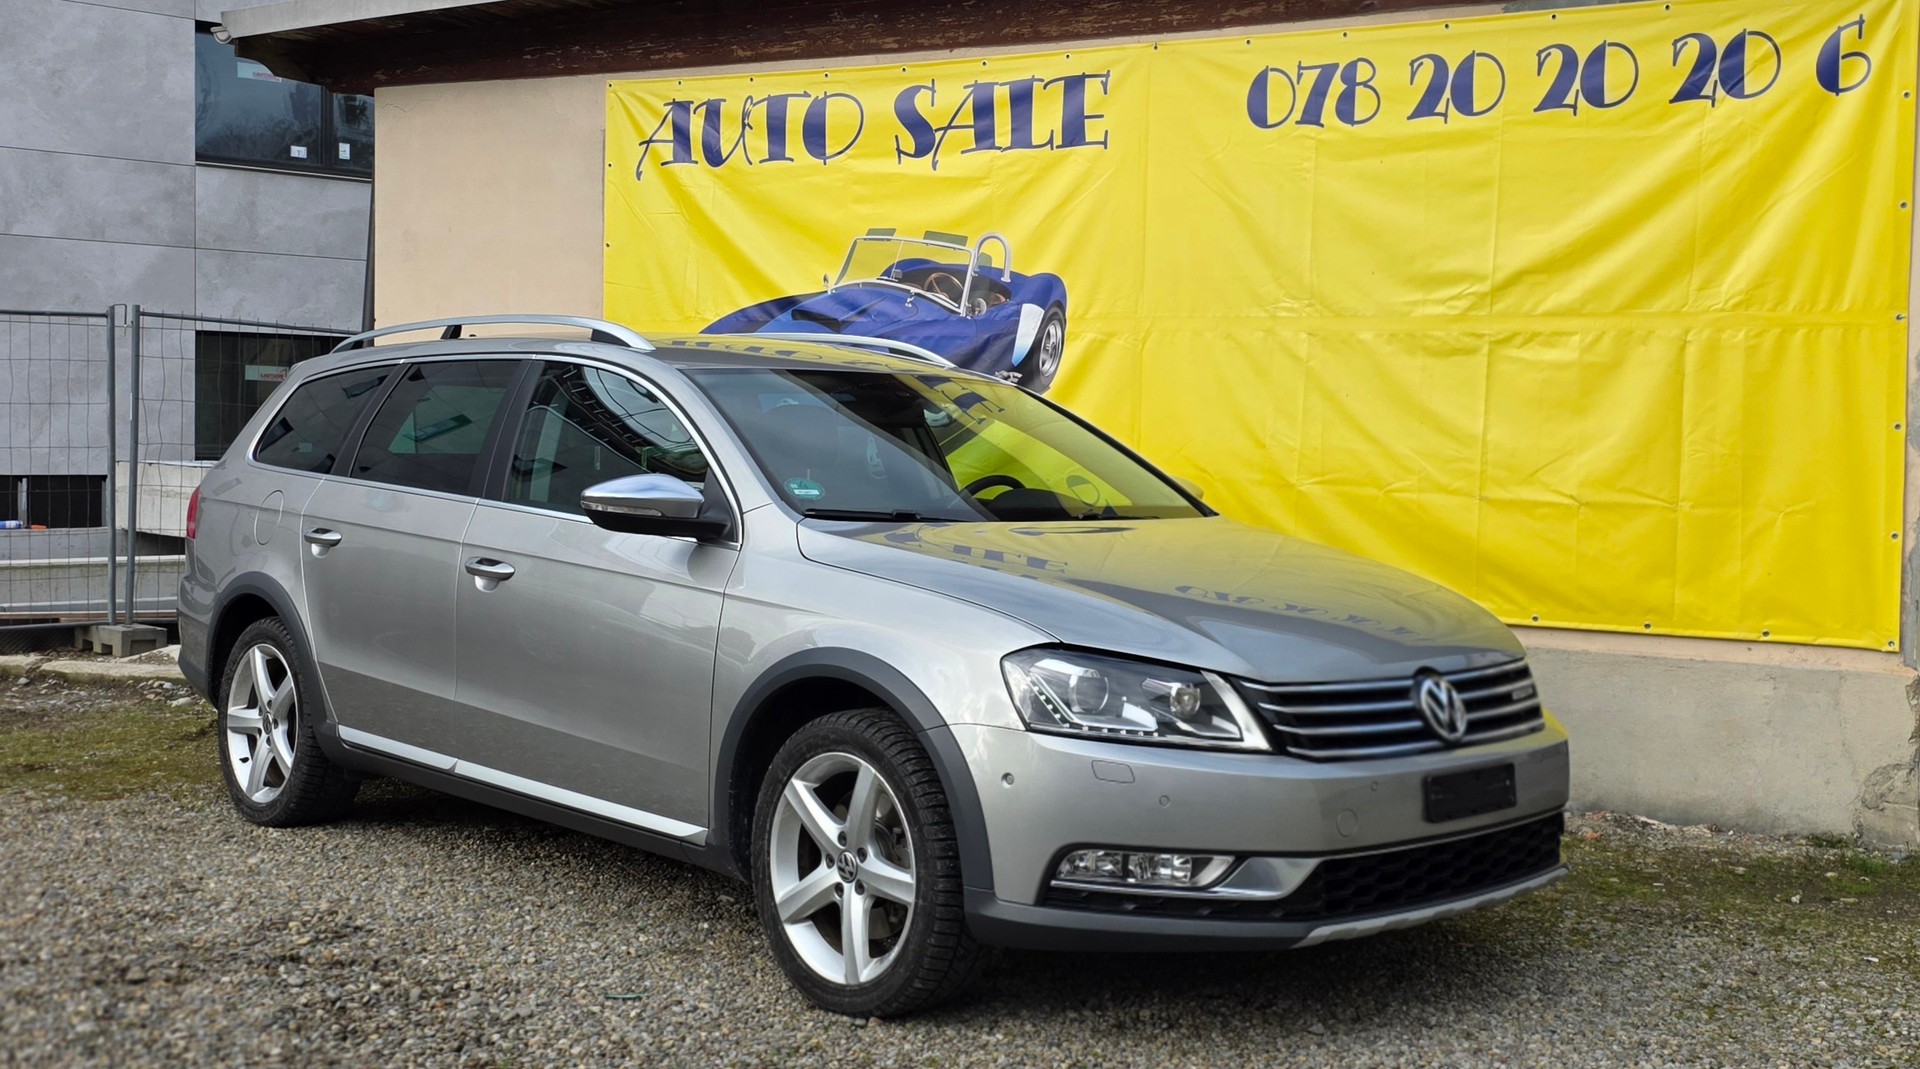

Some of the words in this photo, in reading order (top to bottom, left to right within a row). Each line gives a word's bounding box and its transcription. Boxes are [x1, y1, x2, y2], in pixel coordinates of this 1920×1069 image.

[636, 90, 864, 181] AUTO
[894, 70, 1110, 171] SALE
[1247, 57, 1380, 128] 078
[1406, 50, 1506, 124] 20
[1533, 40, 1639, 116] 20
[1668, 28, 1782, 108] 20
[1816, 13, 1872, 96] 6
